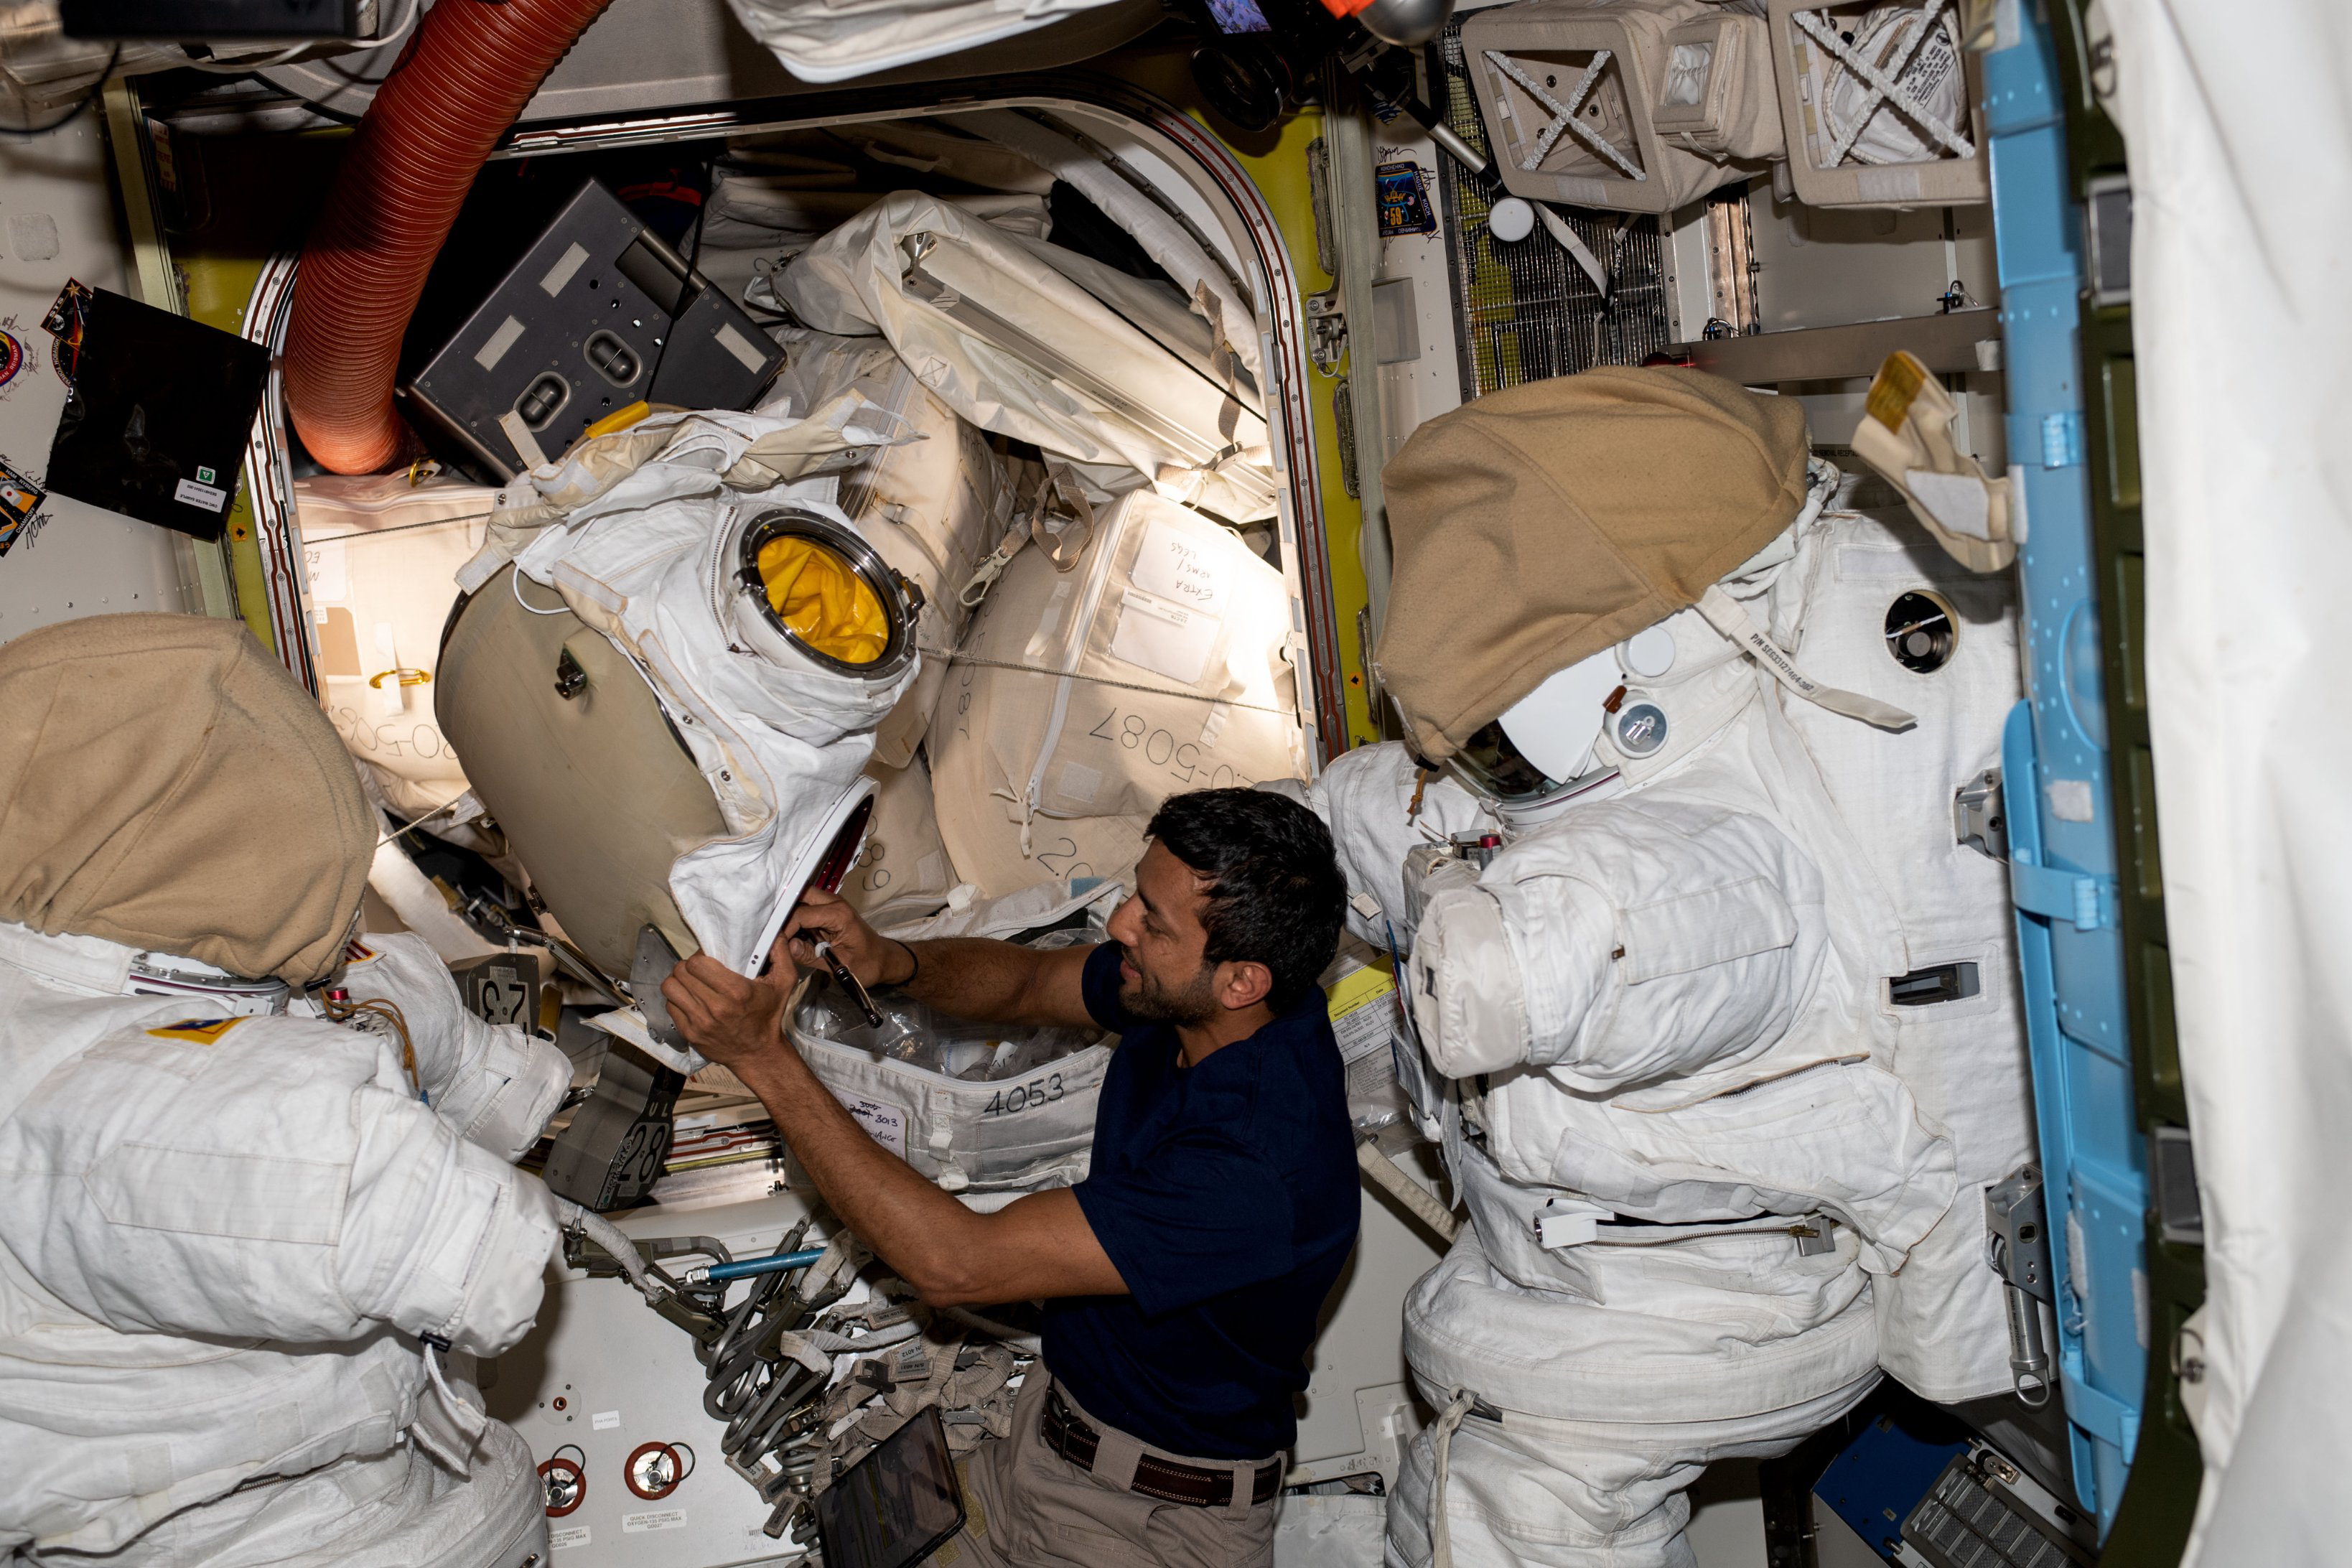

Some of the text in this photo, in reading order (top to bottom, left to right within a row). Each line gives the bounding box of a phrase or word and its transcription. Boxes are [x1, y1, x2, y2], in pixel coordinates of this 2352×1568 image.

[1413, 171, 1432, 216] HAGUE KOCH
[1390, 207, 1402, 226] 59
[48, 297, 64, 318] STS
[56, 367, 72, 386] FOREM
[5, 469, 18, 480] HAM
[19, 479, 39, 495] NYBERG
[179, 493, 195, 502] SAMPLE
[15, 506, 36, 533] CHAMITOFF
[1171, 541, 1198, 559] LEGS
[1175, 579, 1213, 602] EXTRA
[1750, 633, 1765, 648] P/N
[1333, 1007, 1348, 1017] Document
[1348, 1001, 1360, 1009] Number
[984, 1073, 1064, 1116] 4053
[875, 1114, 897, 1126] 3013
[618, 1124, 666, 1182] 28
[902, 1348, 915, 1358] 4012
[627, 1518, 658, 1527] OXYGEN-135
[648, 1511, 678, 1520] DISCONNECT
[551, 1529, 582, 1539] DISCONNECT
